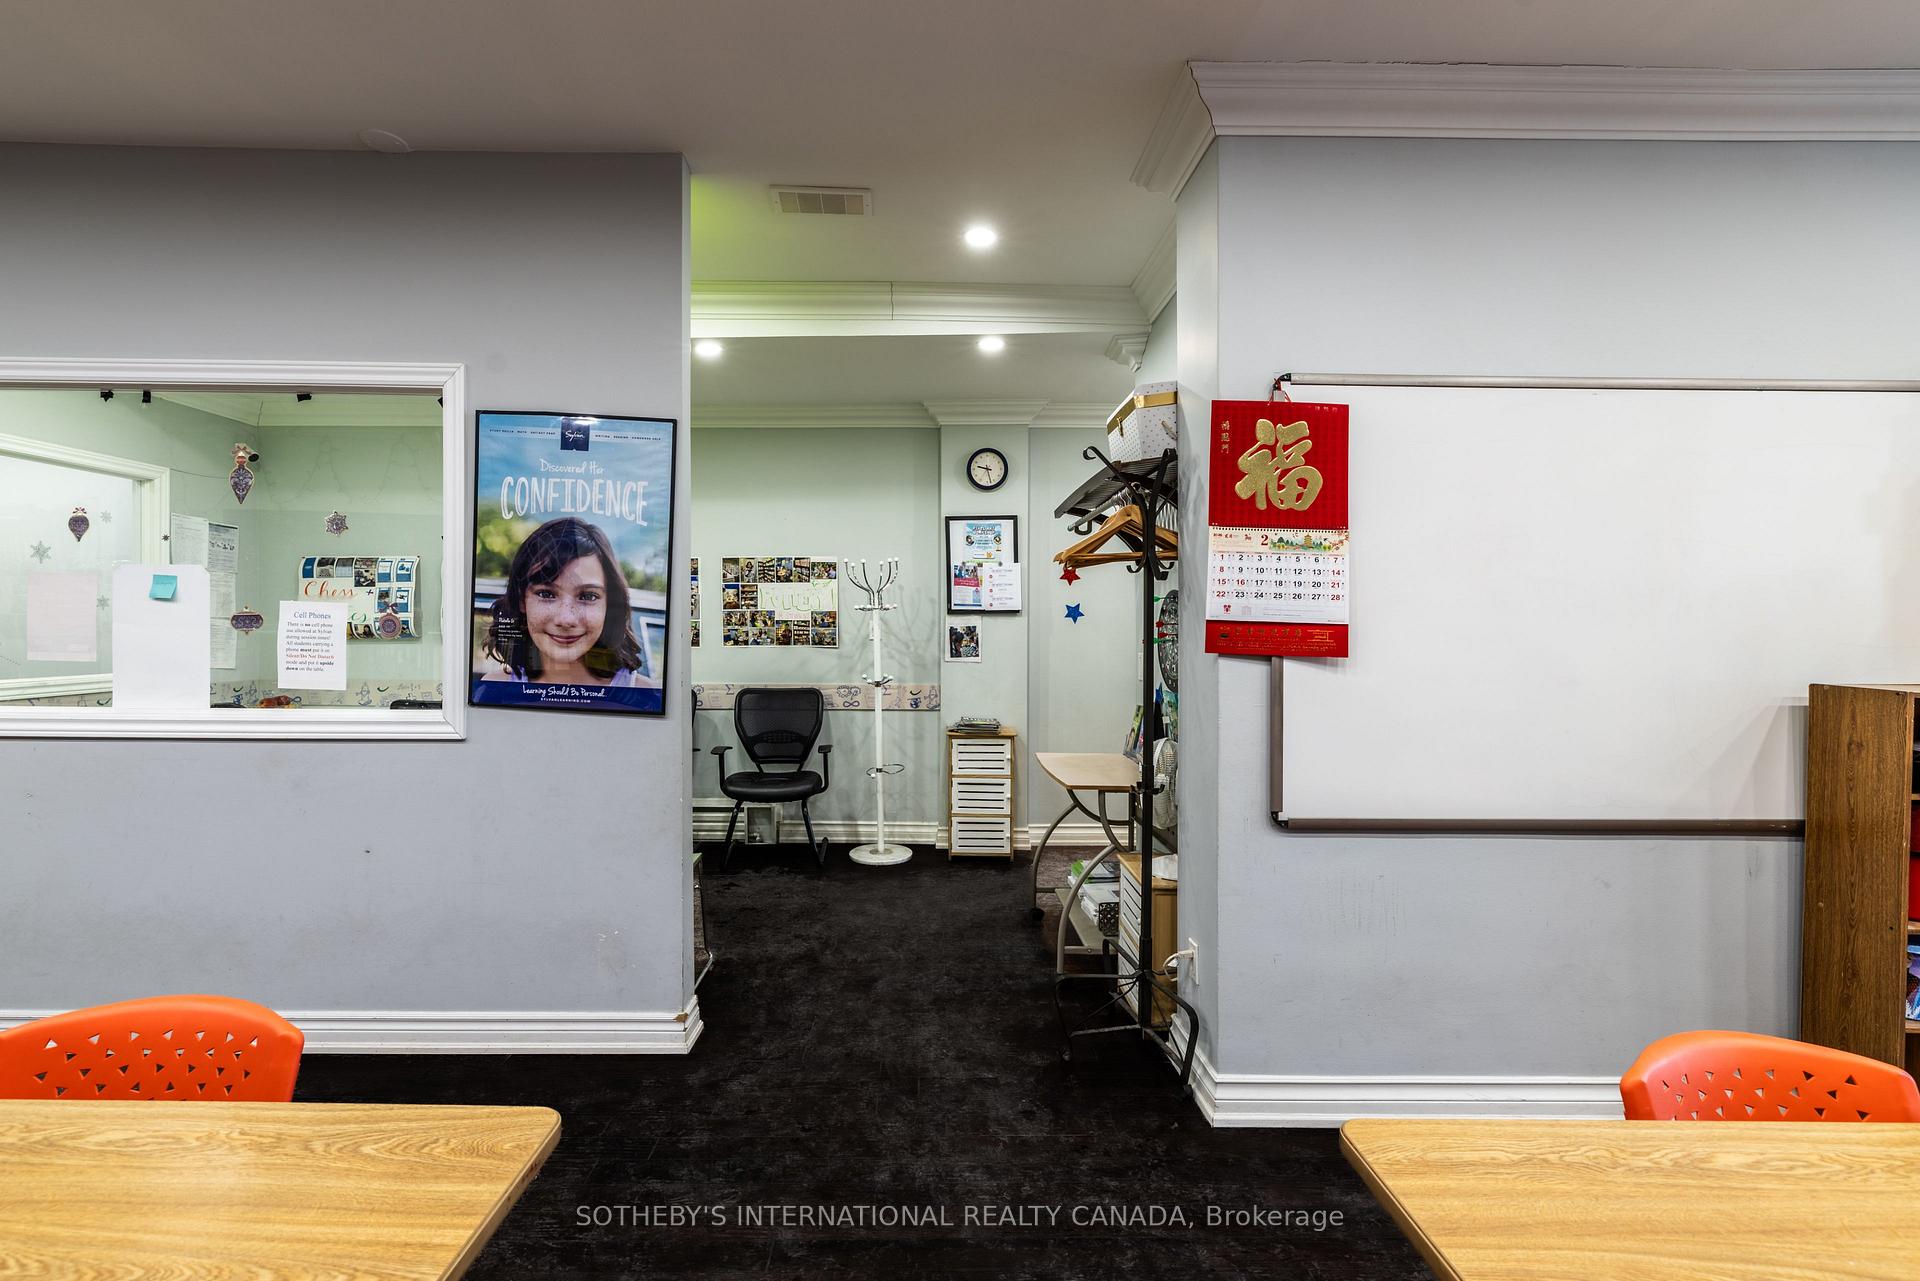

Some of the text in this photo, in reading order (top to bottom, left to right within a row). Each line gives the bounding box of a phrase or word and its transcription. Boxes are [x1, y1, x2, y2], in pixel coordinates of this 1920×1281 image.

[565, 430, 585, 442] Sylvan
[539, 458, 605, 475] Discovered Her
[1235, 419, 1323, 511] 福
[501, 476, 649, 526] CONFIDENCE
[1261, 534, 1269, 546] 2
[304, 580, 357, 599] Chess
[294, 611, 331, 620] Cell Phones
[522, 685, 547, 697] Learning
[548, 686, 569, 696] Should
[570, 687, 580, 696] Be
